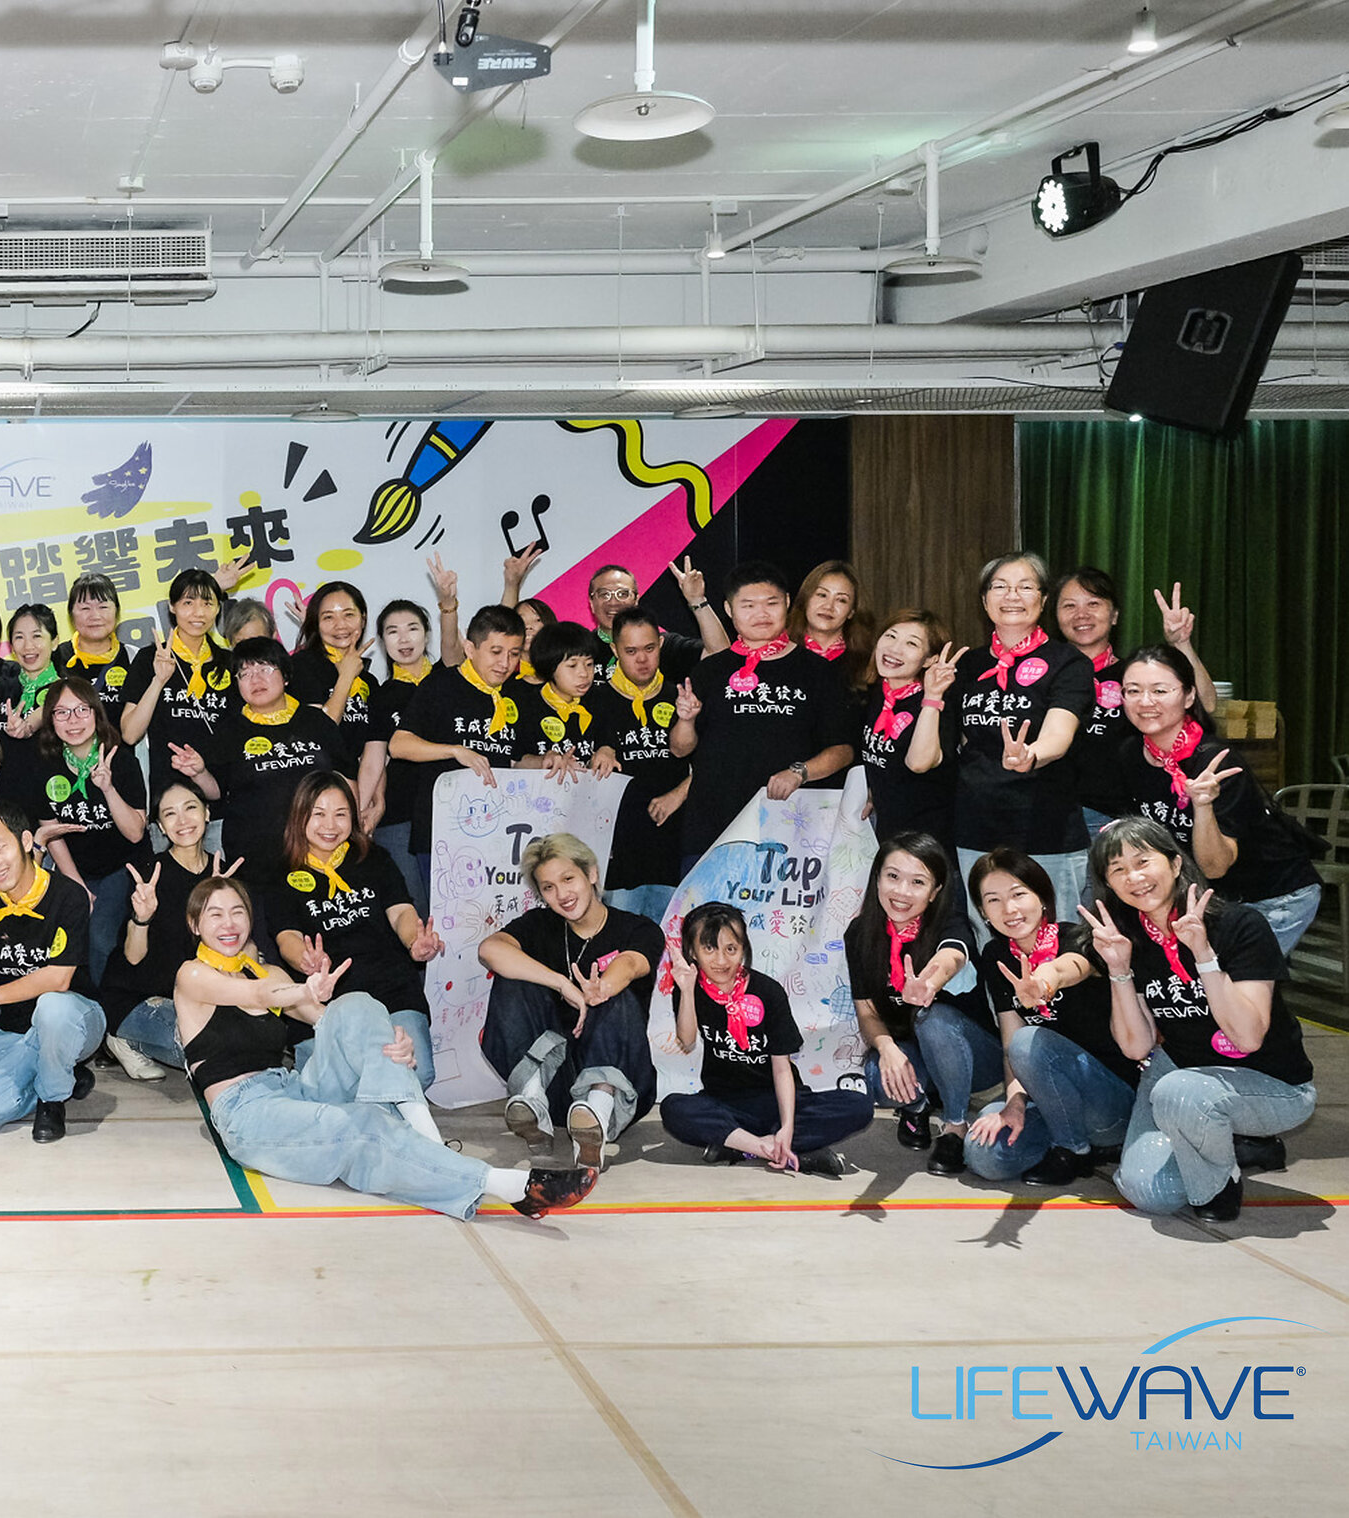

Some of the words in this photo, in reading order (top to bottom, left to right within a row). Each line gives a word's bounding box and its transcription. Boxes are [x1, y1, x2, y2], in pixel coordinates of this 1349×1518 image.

[477, 57, 537, 70] SHURE
[733, 703, 796, 717] LIFEWAVE
[461, 738, 513, 756] LIFEWAVE
[255, 754, 316, 772] LIFEWAVE
[485, 866, 525, 885] Your
[756, 842, 822, 891] Tap
[726, 880, 775, 903] Your
[321, 906, 371, 932] LIFEWAVE
